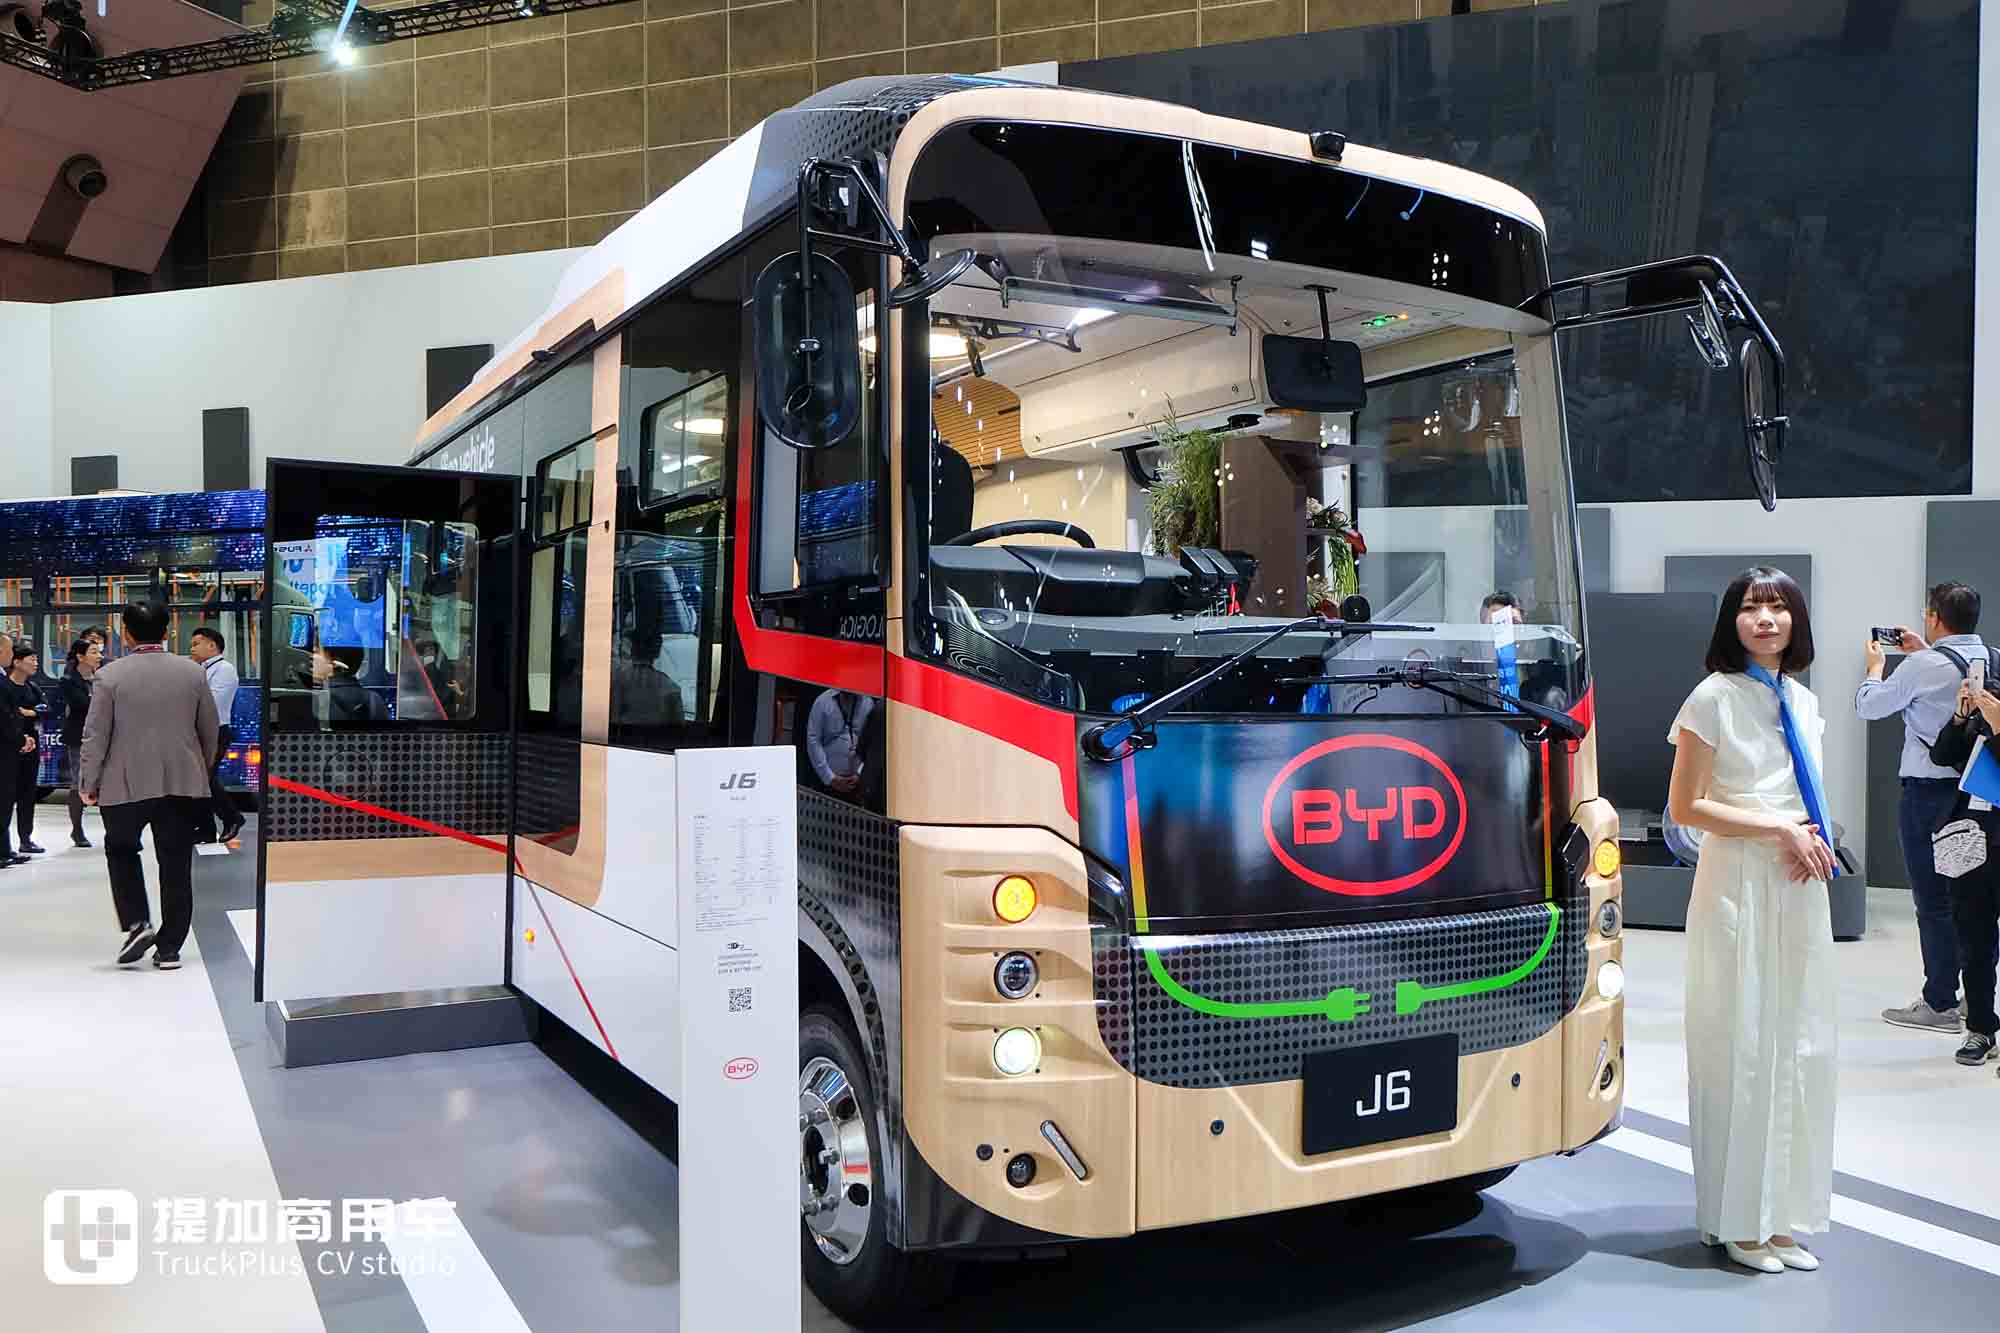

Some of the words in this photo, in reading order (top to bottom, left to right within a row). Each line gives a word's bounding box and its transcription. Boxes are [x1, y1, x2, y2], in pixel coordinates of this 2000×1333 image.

[44, 734, 64, 746] TEC
[720, 773, 757, 790] J6
[1292, 786, 1446, 846] BYD
[727, 1063, 755, 1074] BYD
[1356, 1069, 1411, 1117] J6
